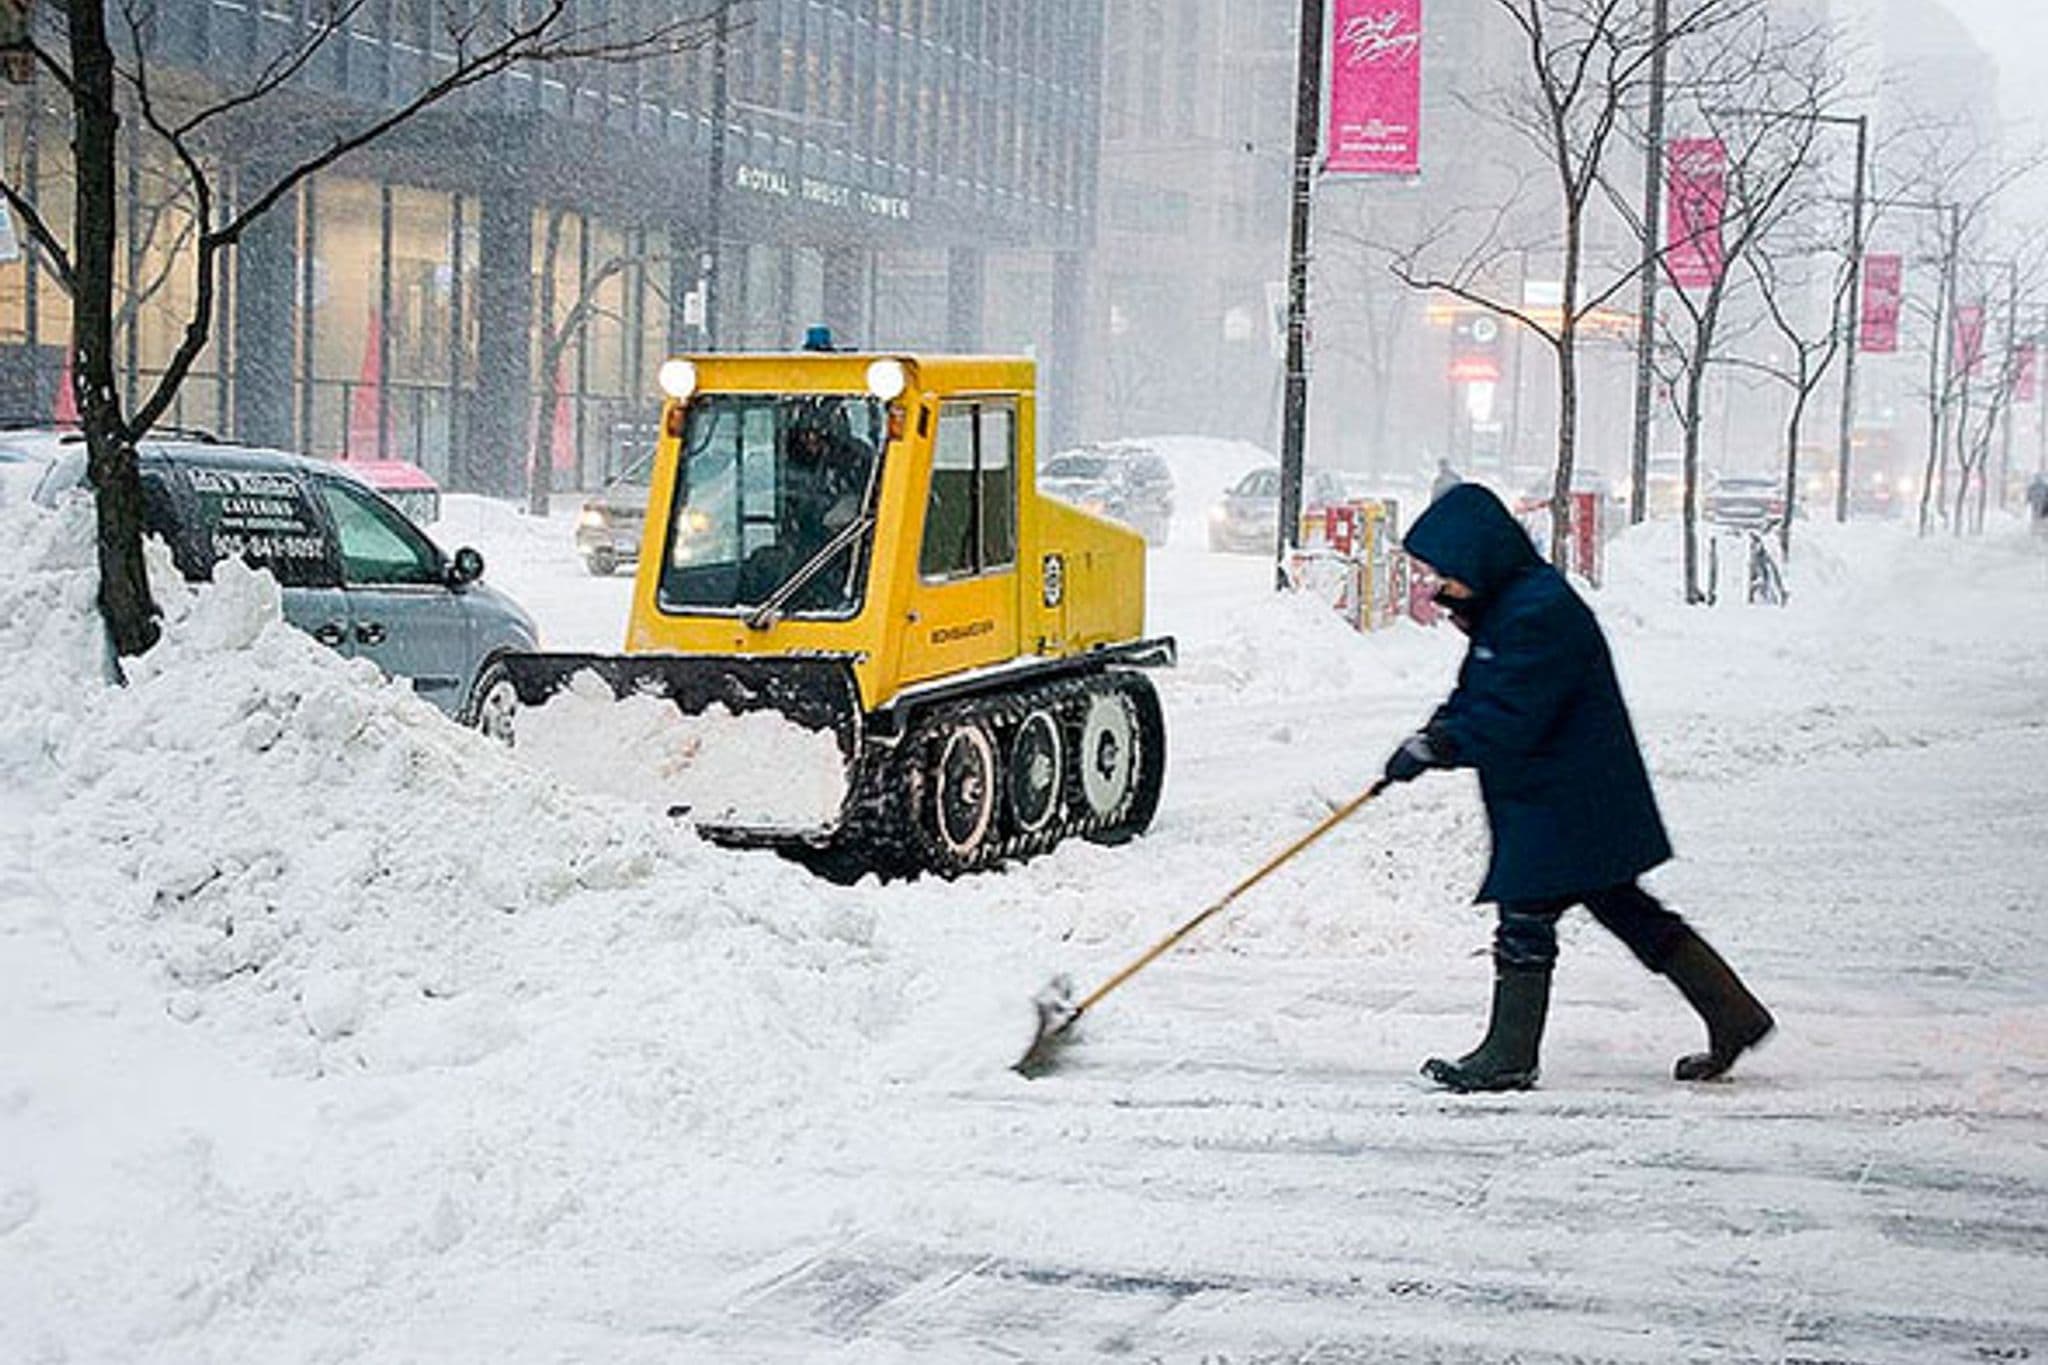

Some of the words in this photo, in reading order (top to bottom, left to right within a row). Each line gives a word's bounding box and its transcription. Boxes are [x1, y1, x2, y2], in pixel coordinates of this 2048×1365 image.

[736, 164, 790, 197] ROYAL
[801, 177, 849, 207] TRUST
[860, 190, 911, 220] TOWER
